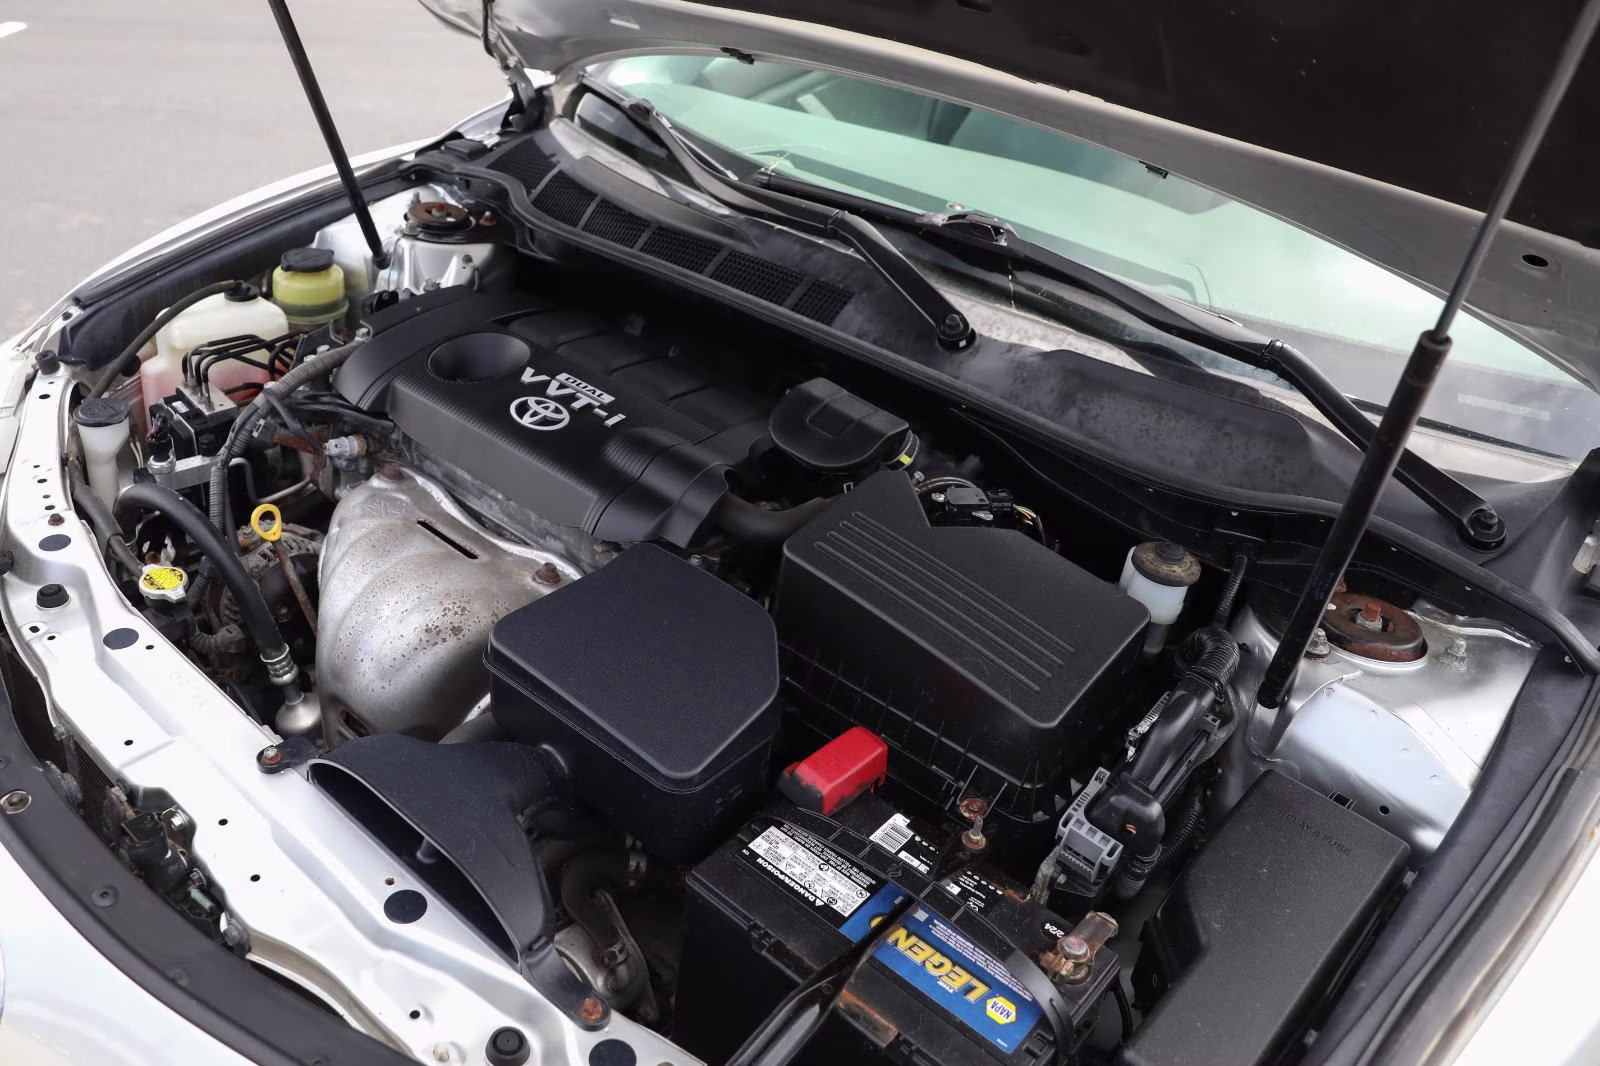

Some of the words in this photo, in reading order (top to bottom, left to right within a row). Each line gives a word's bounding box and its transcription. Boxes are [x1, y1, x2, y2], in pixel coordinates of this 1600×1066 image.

[563, 376, 608, 399] DUAL
[755, 857, 816, 901] DANGER/POISON
[989, 999, 1012, 1020] NAPA
